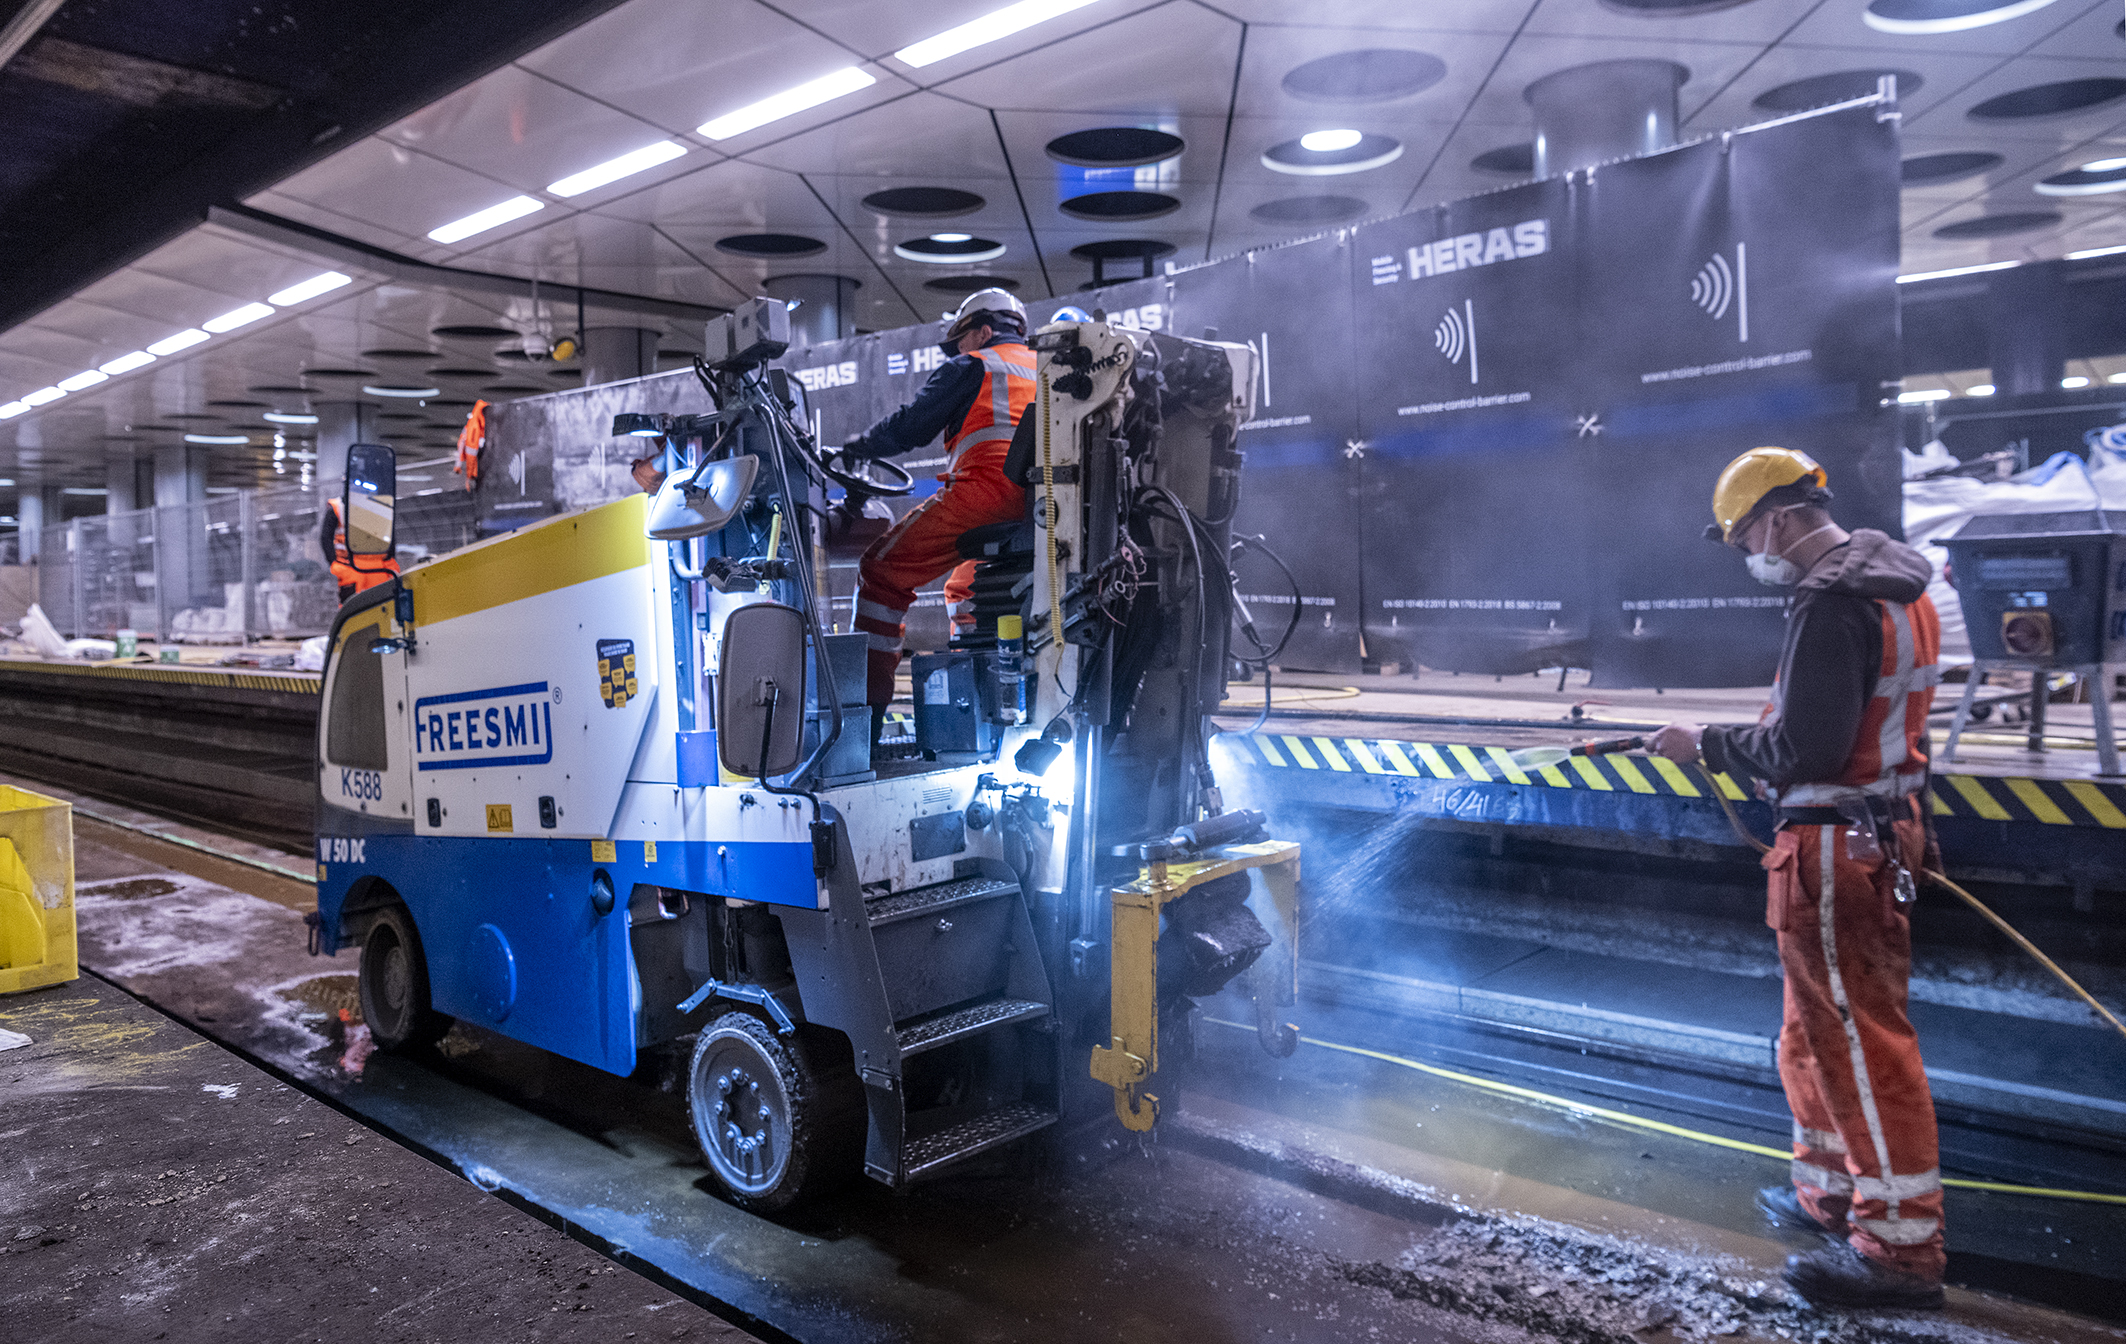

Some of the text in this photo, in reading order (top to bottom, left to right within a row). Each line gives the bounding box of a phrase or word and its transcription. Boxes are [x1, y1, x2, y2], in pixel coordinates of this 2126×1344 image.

[1408, 219, 1546, 280] HERAS
[1106, 303, 1162, 331] RAS
[1397, 391, 1531, 416] www.noise-control-barrier.com
[1239, 414, 1311, 431] e-control-barrier.com
[341, 766, 382, 801] K588
[333, 838, 349, 863] 50
[350, 838, 366, 864] DC
